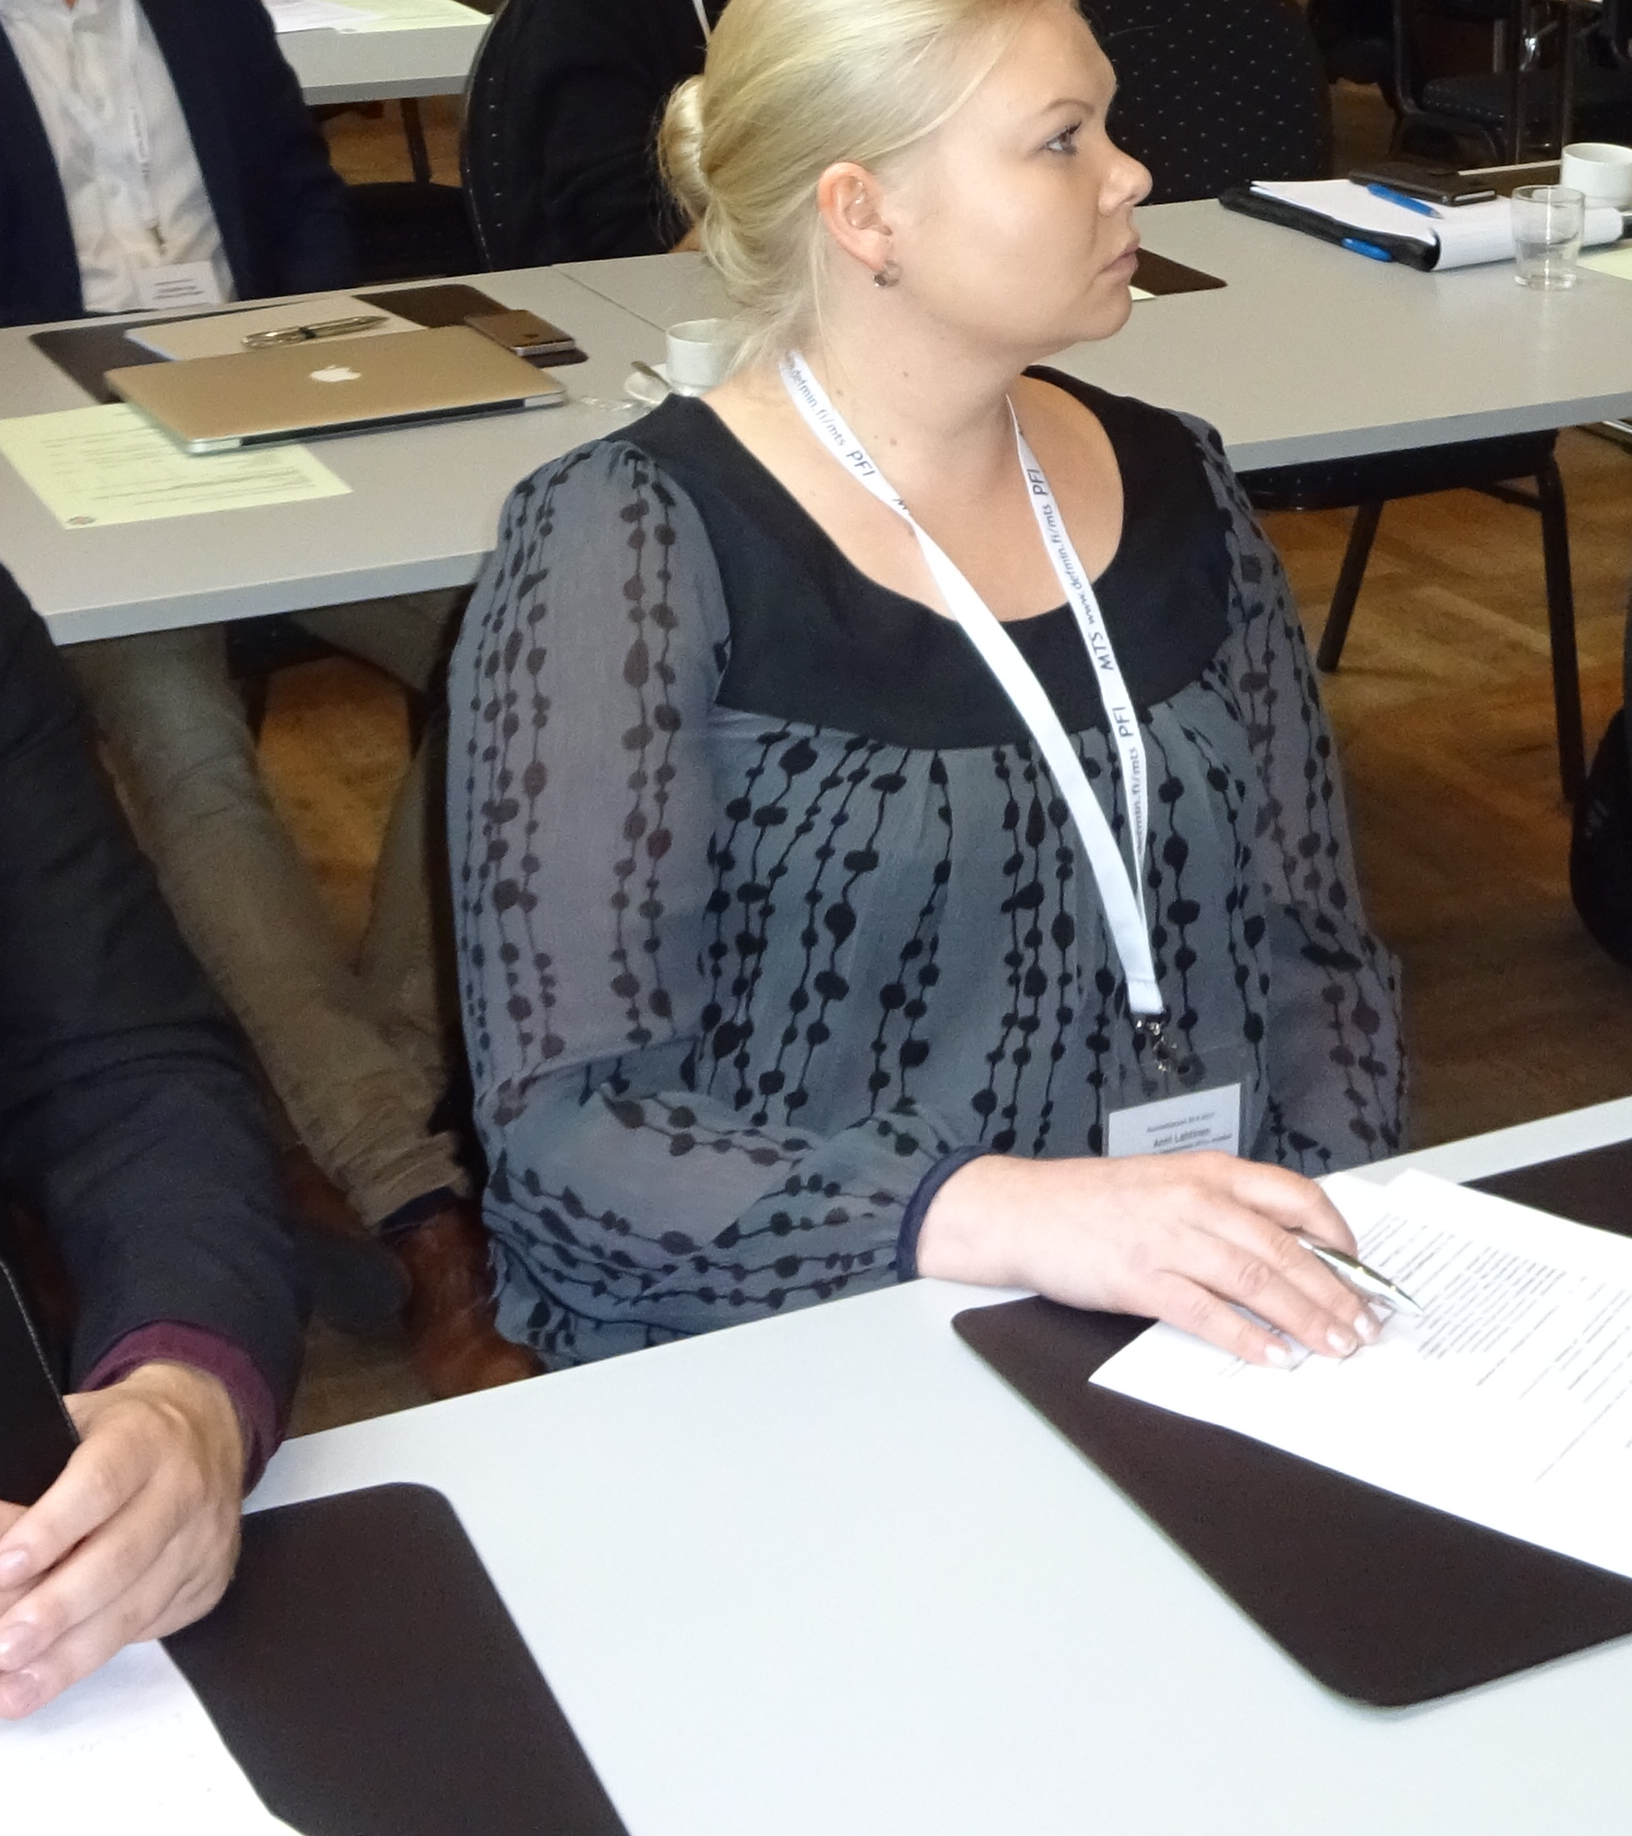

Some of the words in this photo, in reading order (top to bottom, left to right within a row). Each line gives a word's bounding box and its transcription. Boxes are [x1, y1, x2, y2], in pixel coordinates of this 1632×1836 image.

[845, 449, 876, 477] PFI
[1026, 468, 1050, 496] PFI
[1088, 630, 1115, 671] MTS
[1111, 706, 1135, 738] PFI
